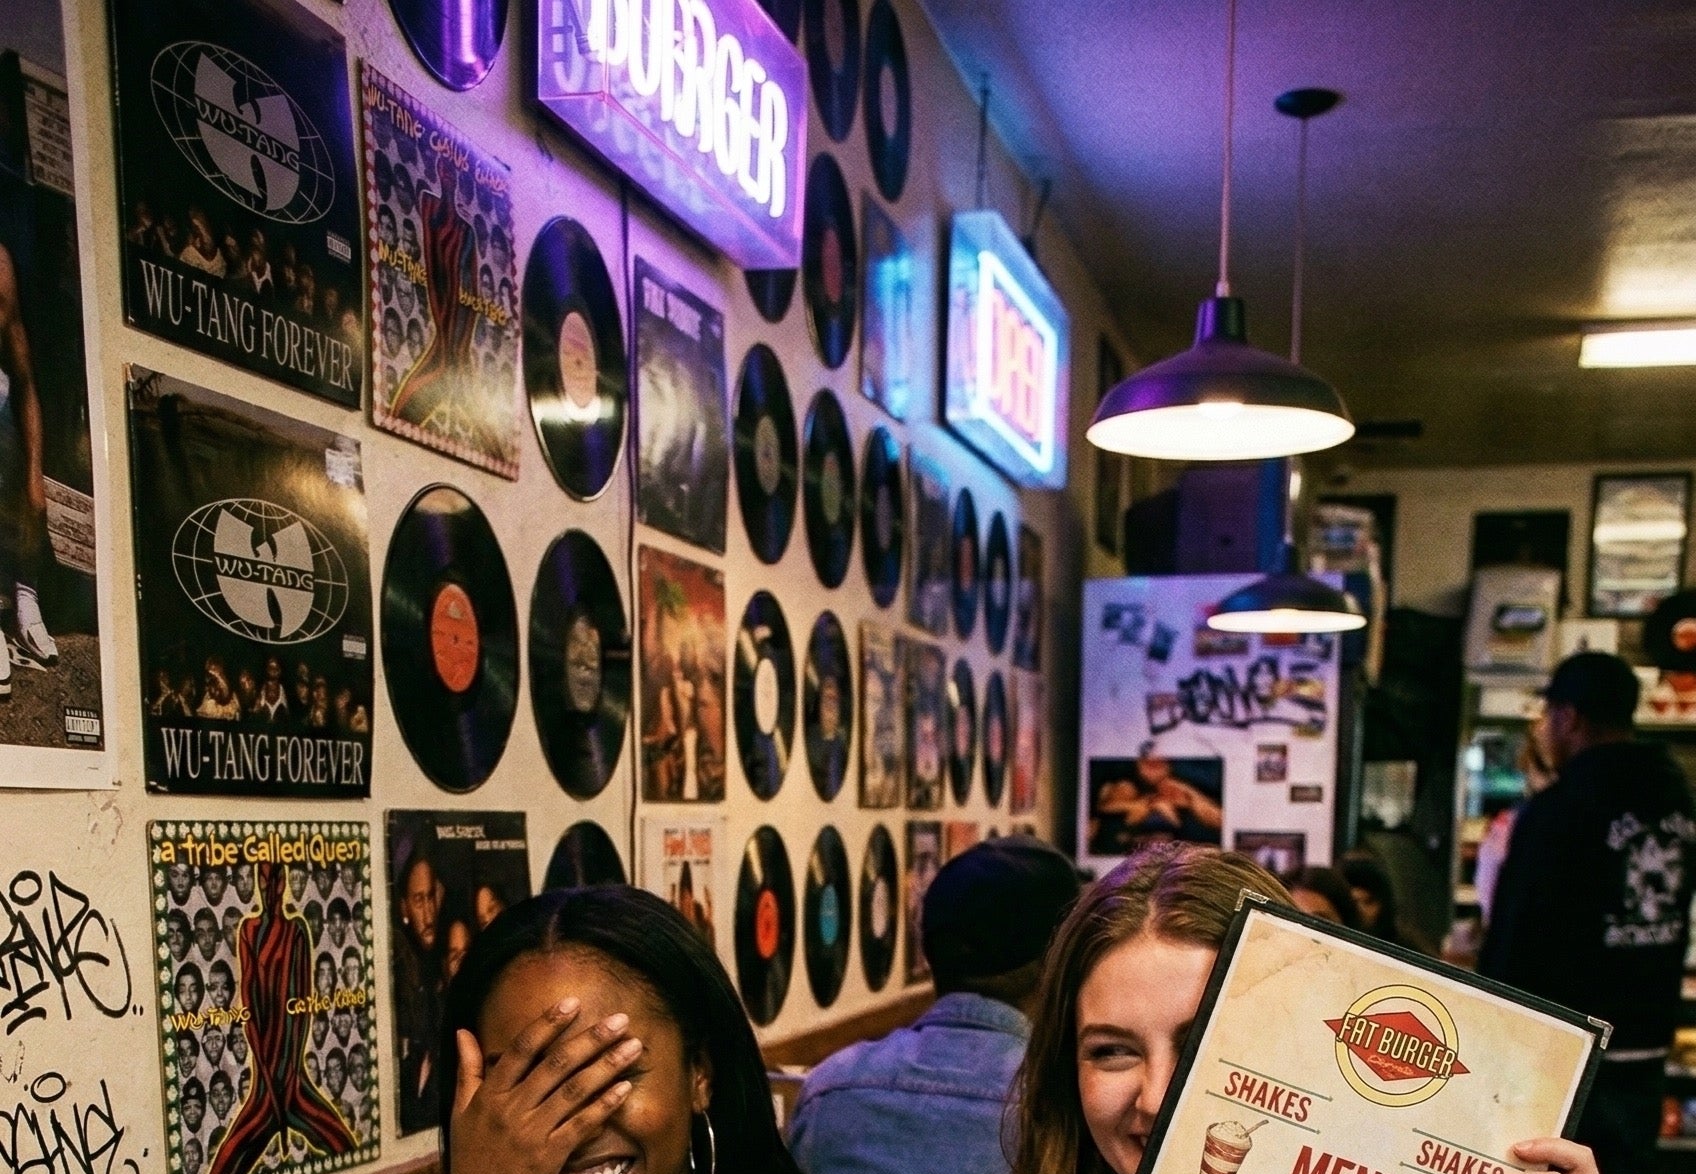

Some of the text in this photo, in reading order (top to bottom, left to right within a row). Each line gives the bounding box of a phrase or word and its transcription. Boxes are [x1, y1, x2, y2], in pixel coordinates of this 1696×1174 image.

[195, 97, 299, 171] WU-TANG
[139, 259, 354, 391] WU-TANG FOREVER
[215, 556, 313, 590] WU-TANG
[161, 727, 364, 785] WU-TANG FOREVER
[161, 841, 175, 863] a
[180, 833, 238, 867] tribe
[243, 832, 305, 864] Called
[1337, 1013, 1380, 1049] FAT
[1377, 1027, 1456, 1078] BURGER
[1224, 1071, 1312, 1122] SHAKES
